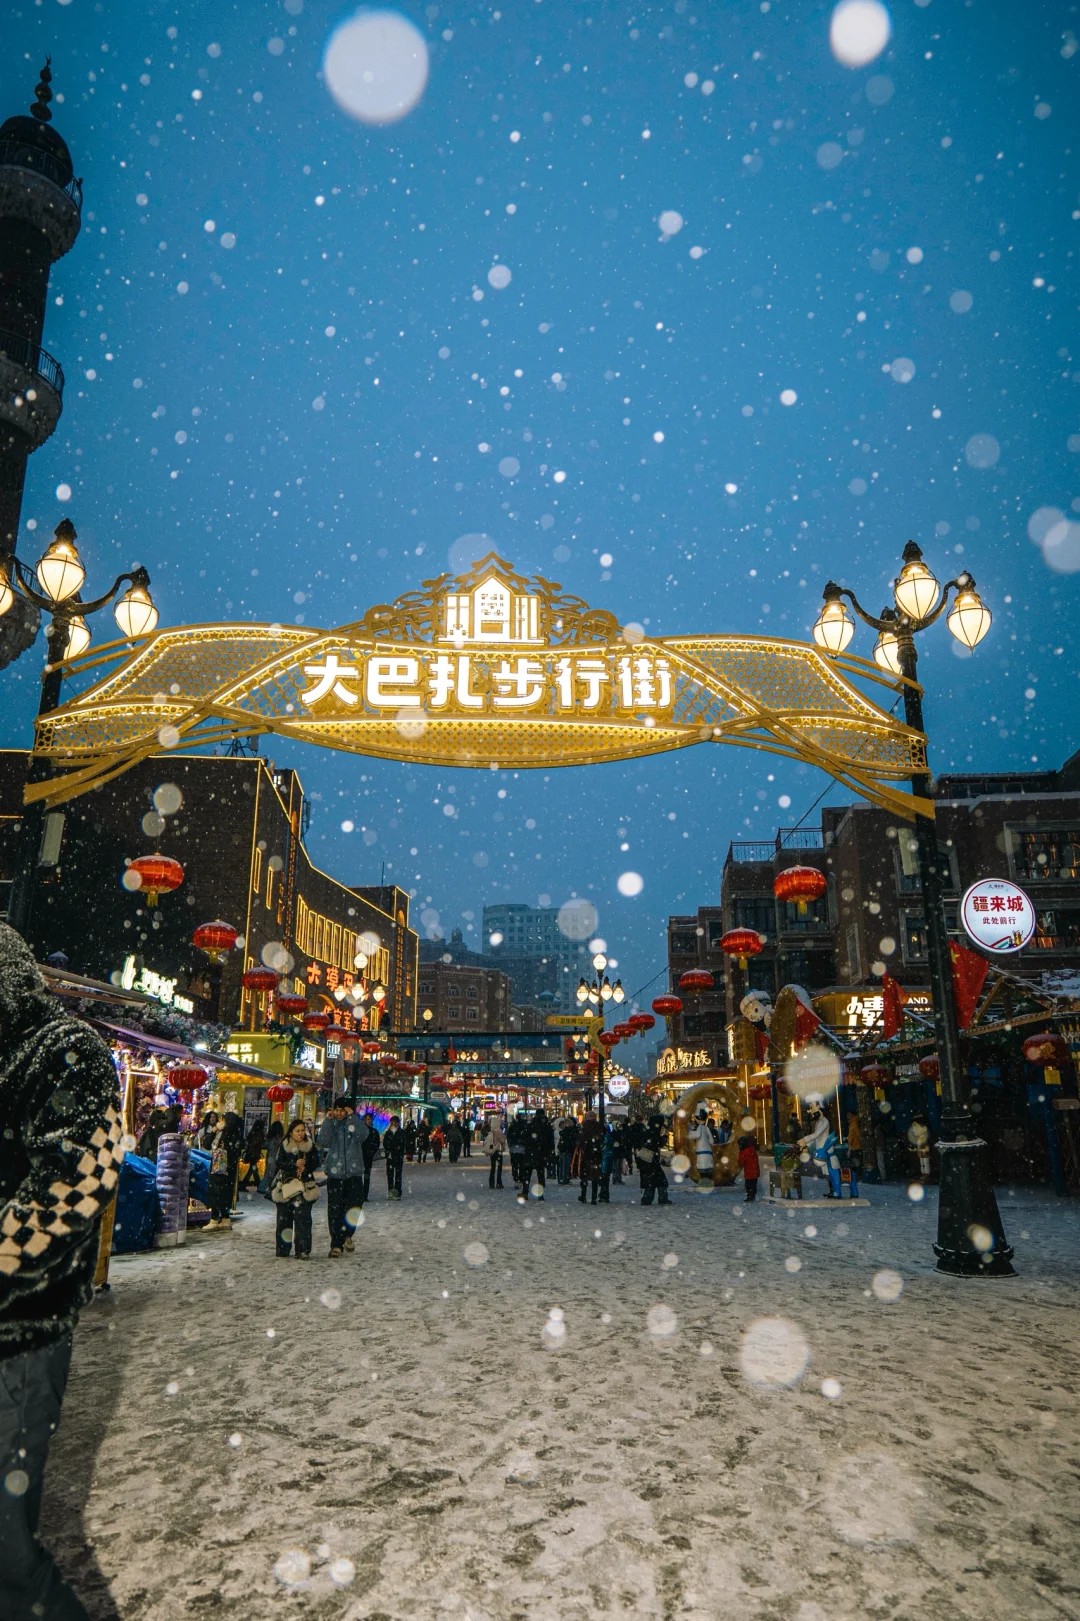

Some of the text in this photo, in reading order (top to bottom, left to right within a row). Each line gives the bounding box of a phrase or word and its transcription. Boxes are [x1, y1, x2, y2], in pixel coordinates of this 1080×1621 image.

[301, 654, 675, 709] 大巴扎步行街
[972, 895, 1024, 912] 疆来城
[982, 916, 1017, 925] 此处前行
